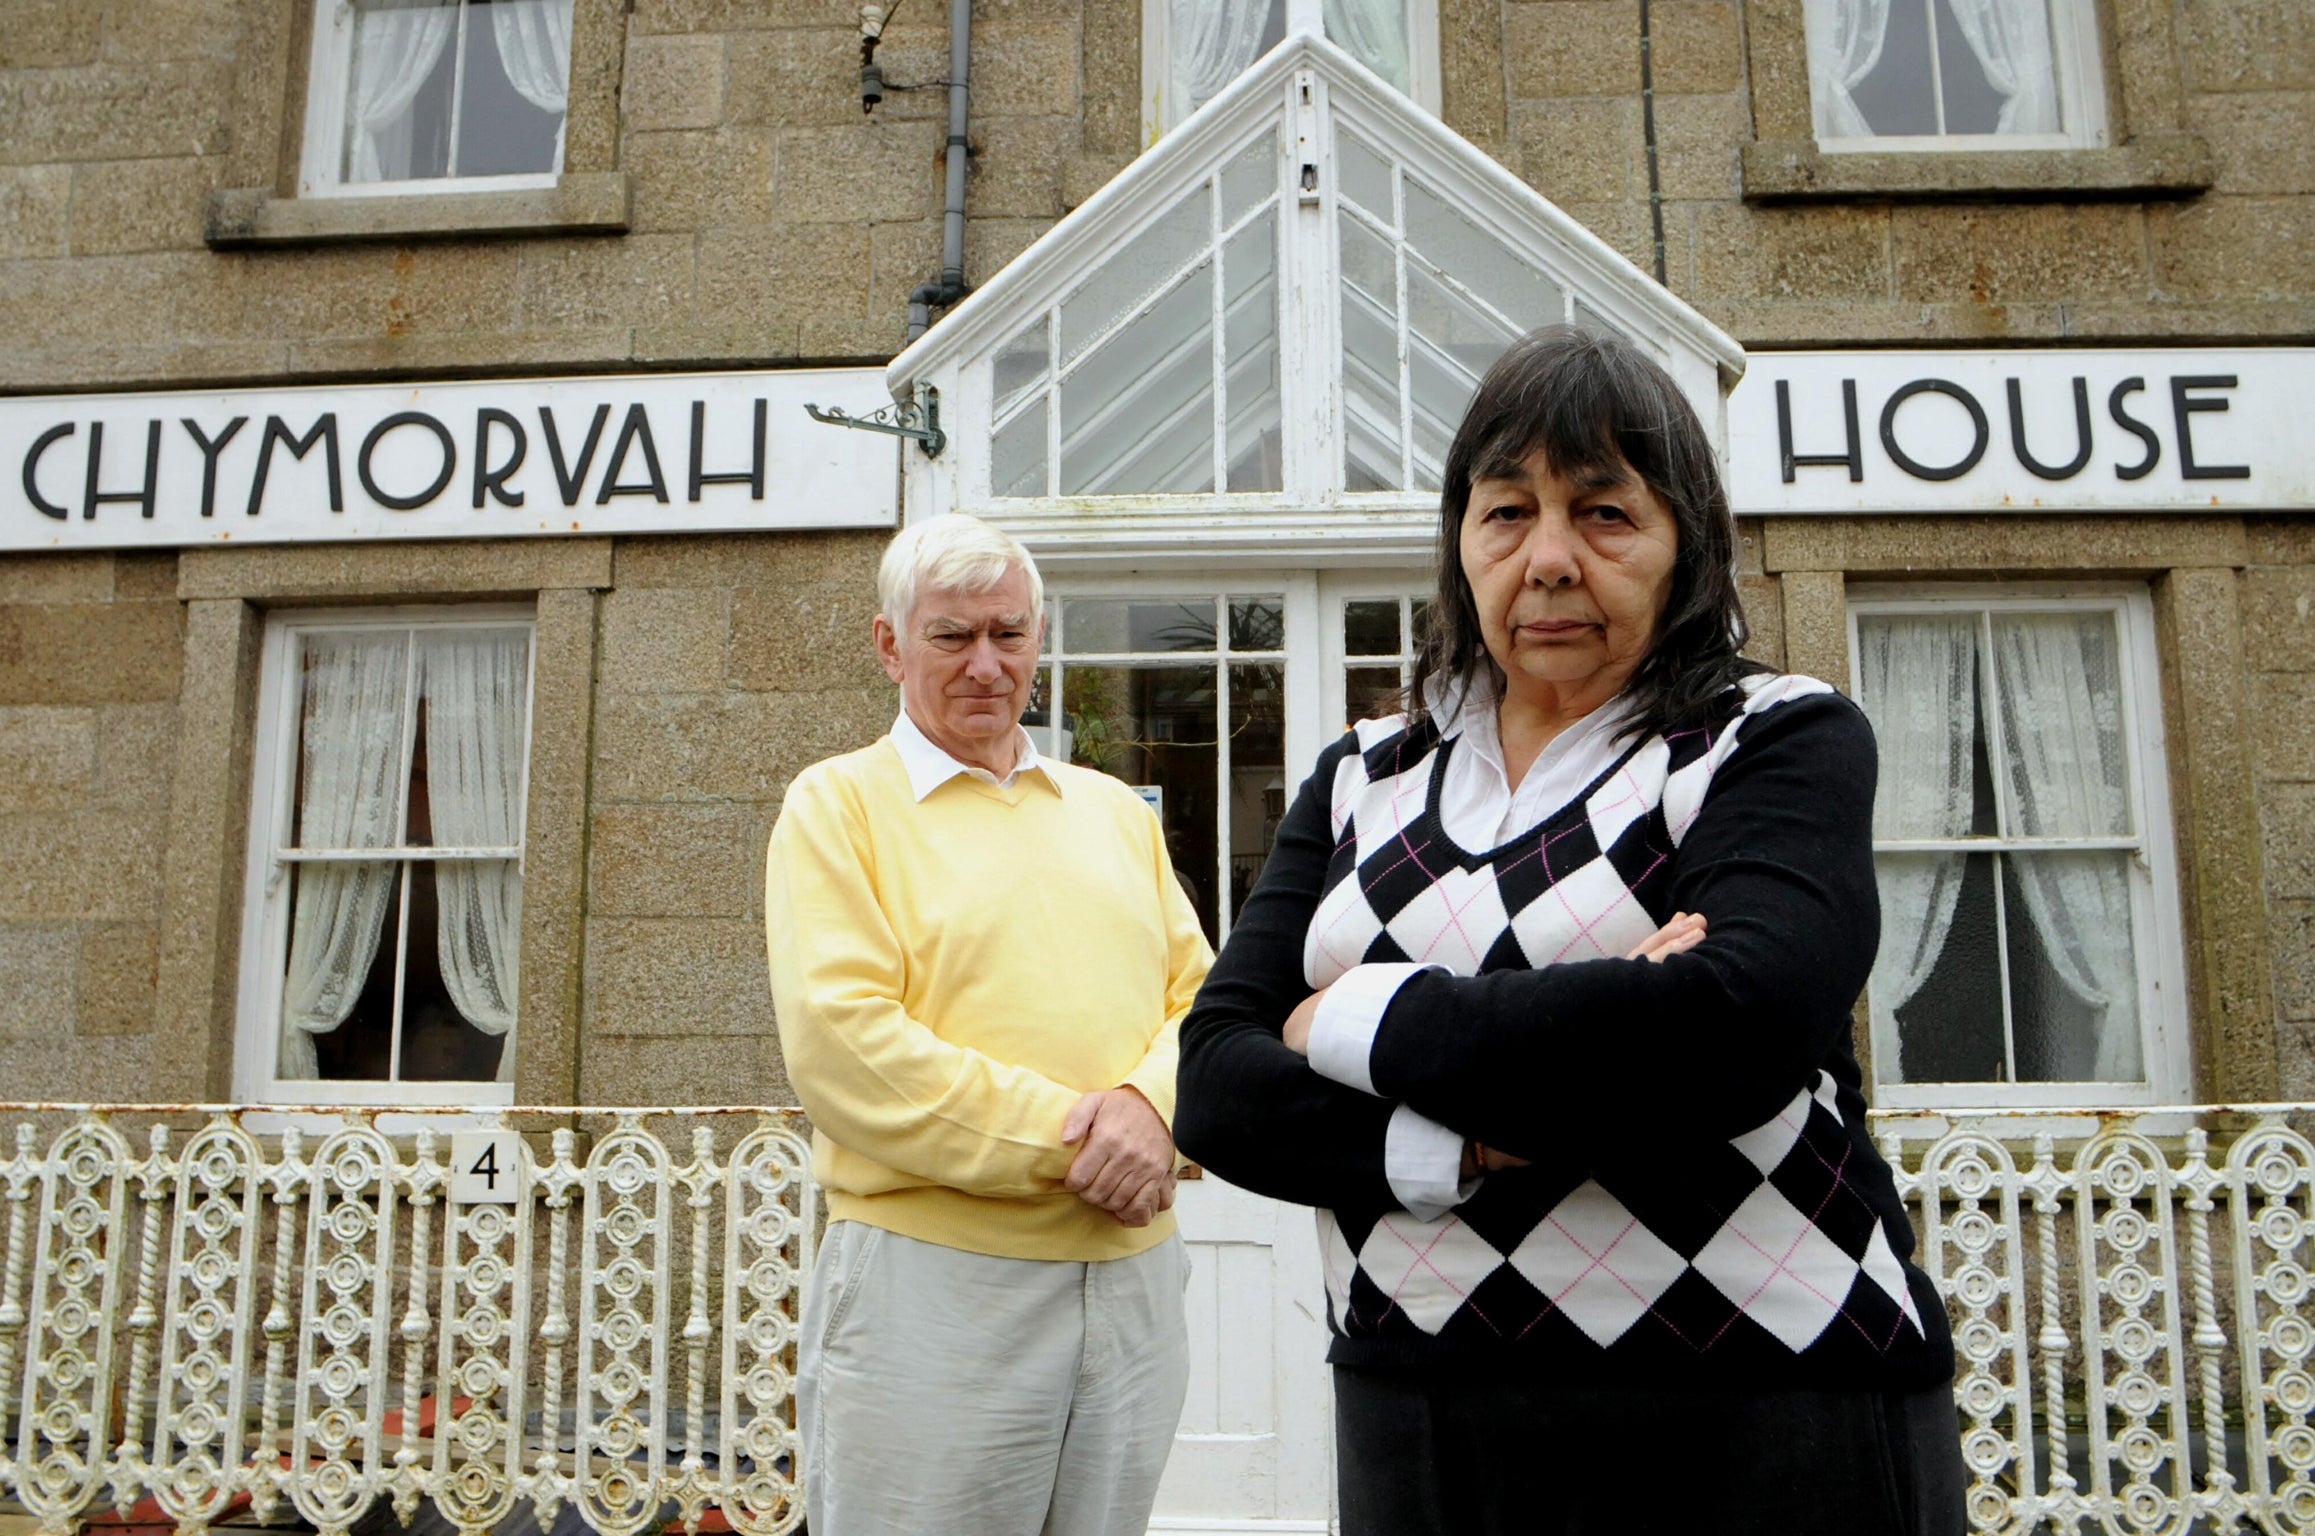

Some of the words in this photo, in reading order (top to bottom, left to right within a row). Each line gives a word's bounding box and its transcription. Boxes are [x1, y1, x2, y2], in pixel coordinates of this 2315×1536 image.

[22, 398, 767, 521] CHYMORVAH
[1775, 375, 2251, 484] HOUSE
[469, 1142, 500, 1190] 4
